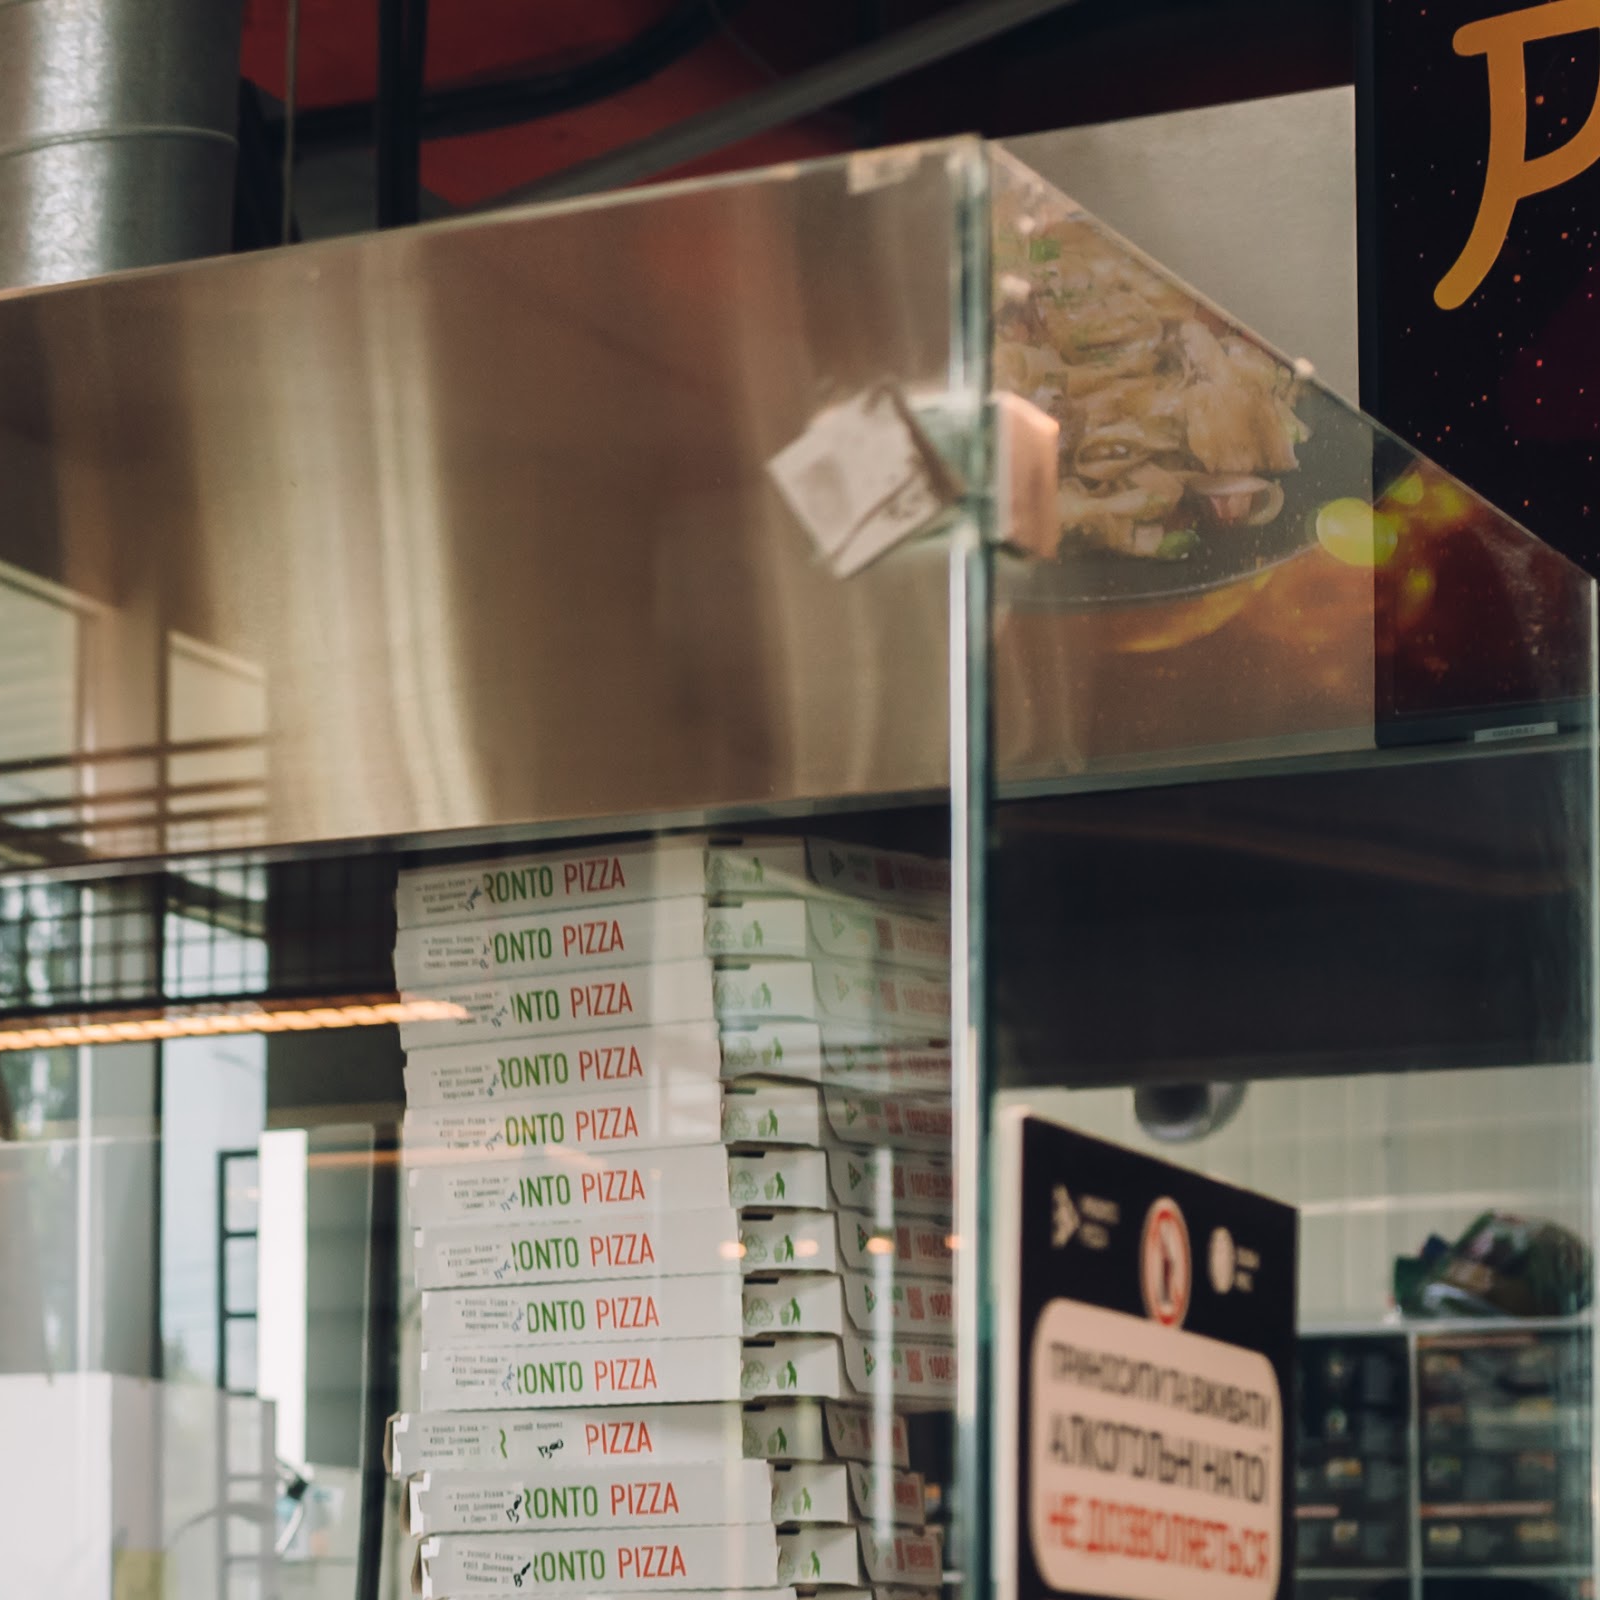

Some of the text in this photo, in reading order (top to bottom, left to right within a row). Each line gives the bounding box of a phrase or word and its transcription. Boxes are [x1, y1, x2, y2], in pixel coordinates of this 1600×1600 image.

[484, 865, 554, 904] RONTO
[563, 856, 626, 895] PIZZA
[490, 927, 553, 965] ONTO
[562, 920, 625, 957] PIZZA
[569, 981, 633, 1018] PIZZA
[578, 1046, 643, 1082] PIZZA
[505, 1112, 565, 1147] ONTO
[575, 1105, 639, 1142] PIZZA
[580, 1169, 646, 1204] PIZZA
[511, 1236, 580, 1272] ONTO
[589, 1231, 656, 1267] PIZZA
[527, 1298, 587, 1334] ONTO
[595, 1294, 660, 1330] PIZZA
[516, 1360, 585, 1395] ONTO
[593, 1356, 658, 1392] PIZZA
[585, 1420, 654, 1455] PIZZA
[610, 1481, 680, 1516] PIZZA
[617, 1544, 687, 1579] PIZZA
